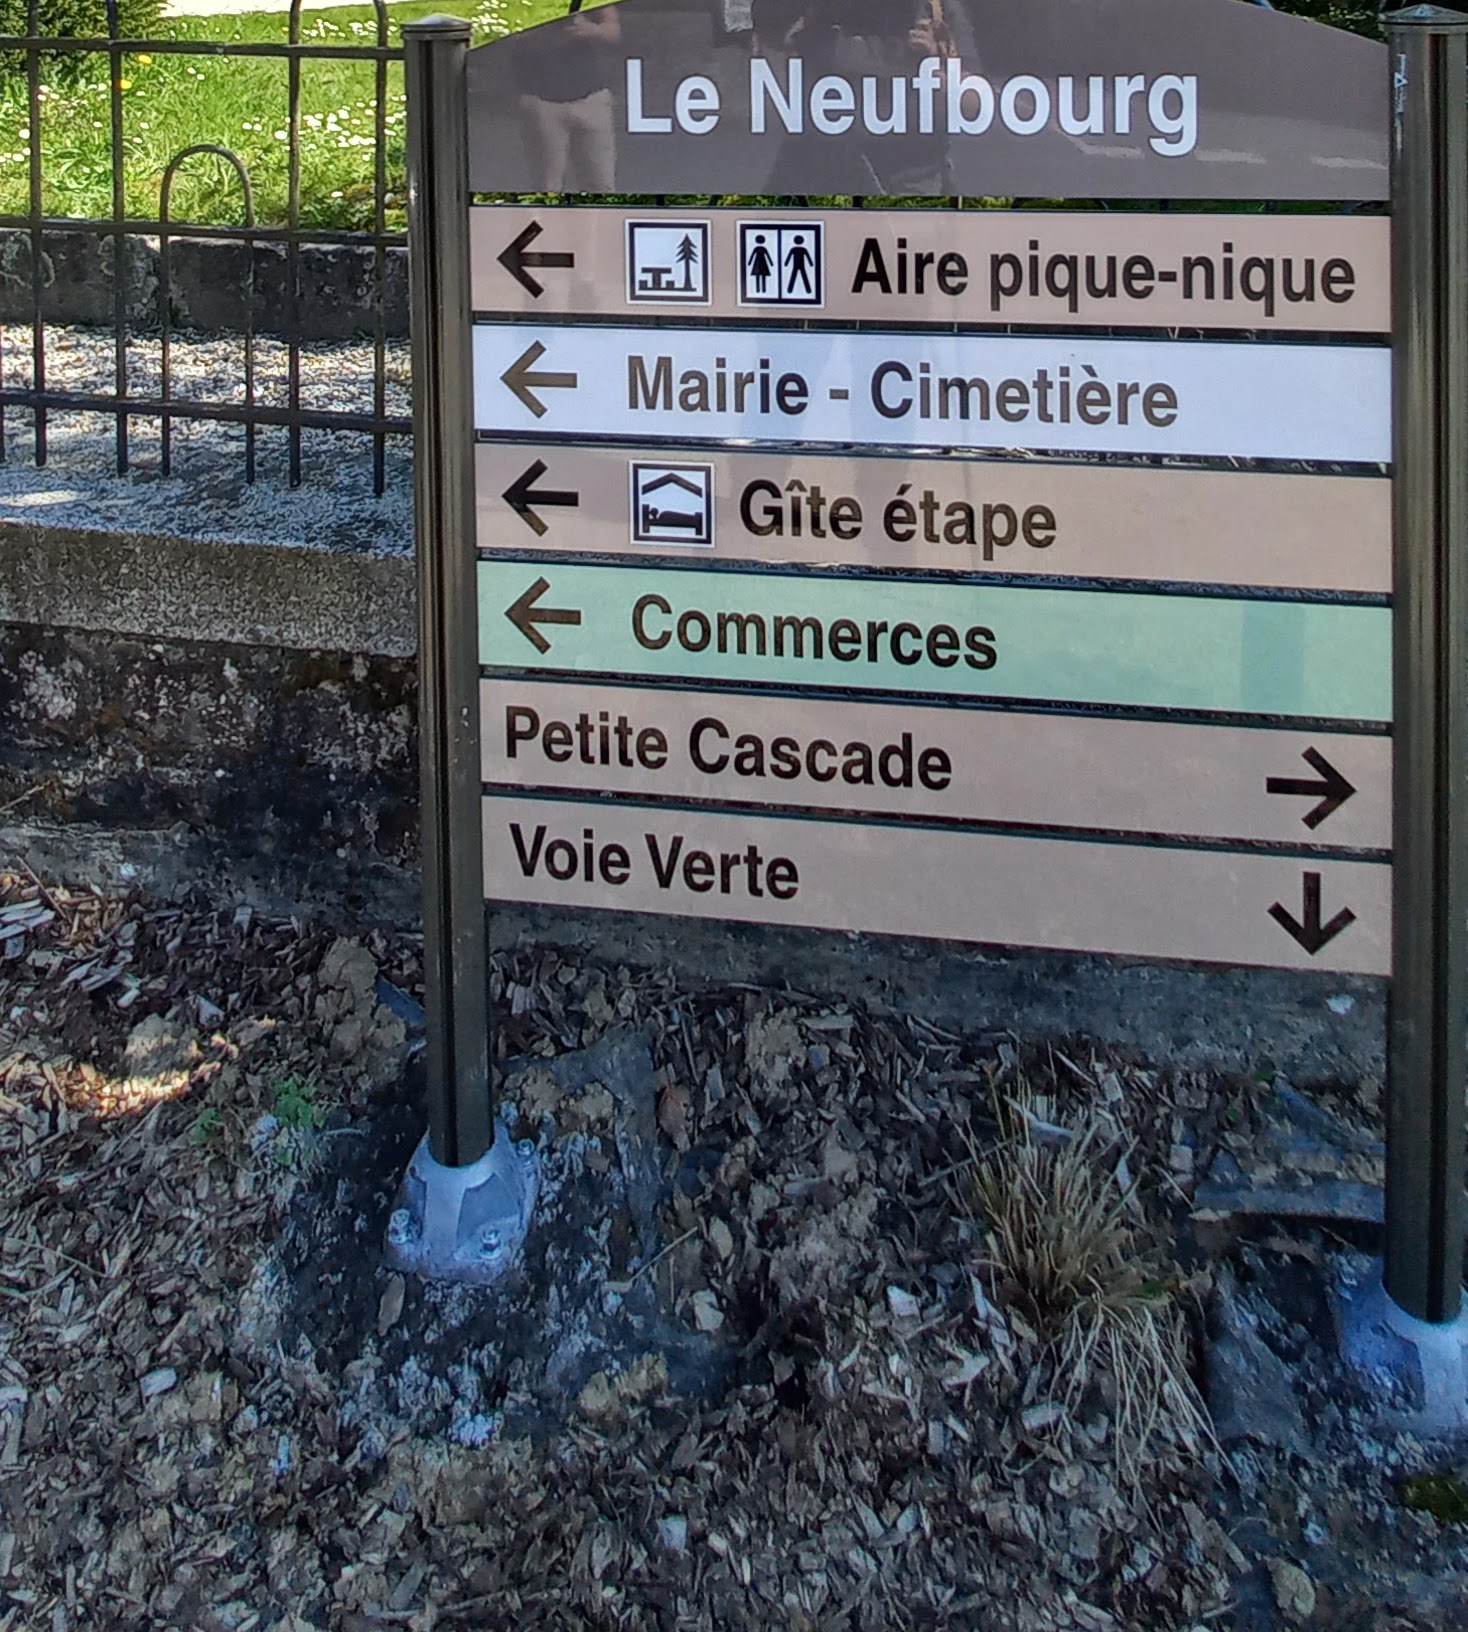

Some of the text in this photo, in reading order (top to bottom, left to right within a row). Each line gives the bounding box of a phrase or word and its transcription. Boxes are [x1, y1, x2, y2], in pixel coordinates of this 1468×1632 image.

[627, 57, 1196, 156] Le Neufbourg
[852, 238, 1355, 317] Aire pique-nique
[628, 356, 1177, 427] Mairie - Cimetière
[740, 480, 1056, 561] Gîte étape
[632, 594, 997, 670] Commerces
[507, 706, 951, 790] Petite Cascade
[510, 823, 798, 899] Voie Verte
